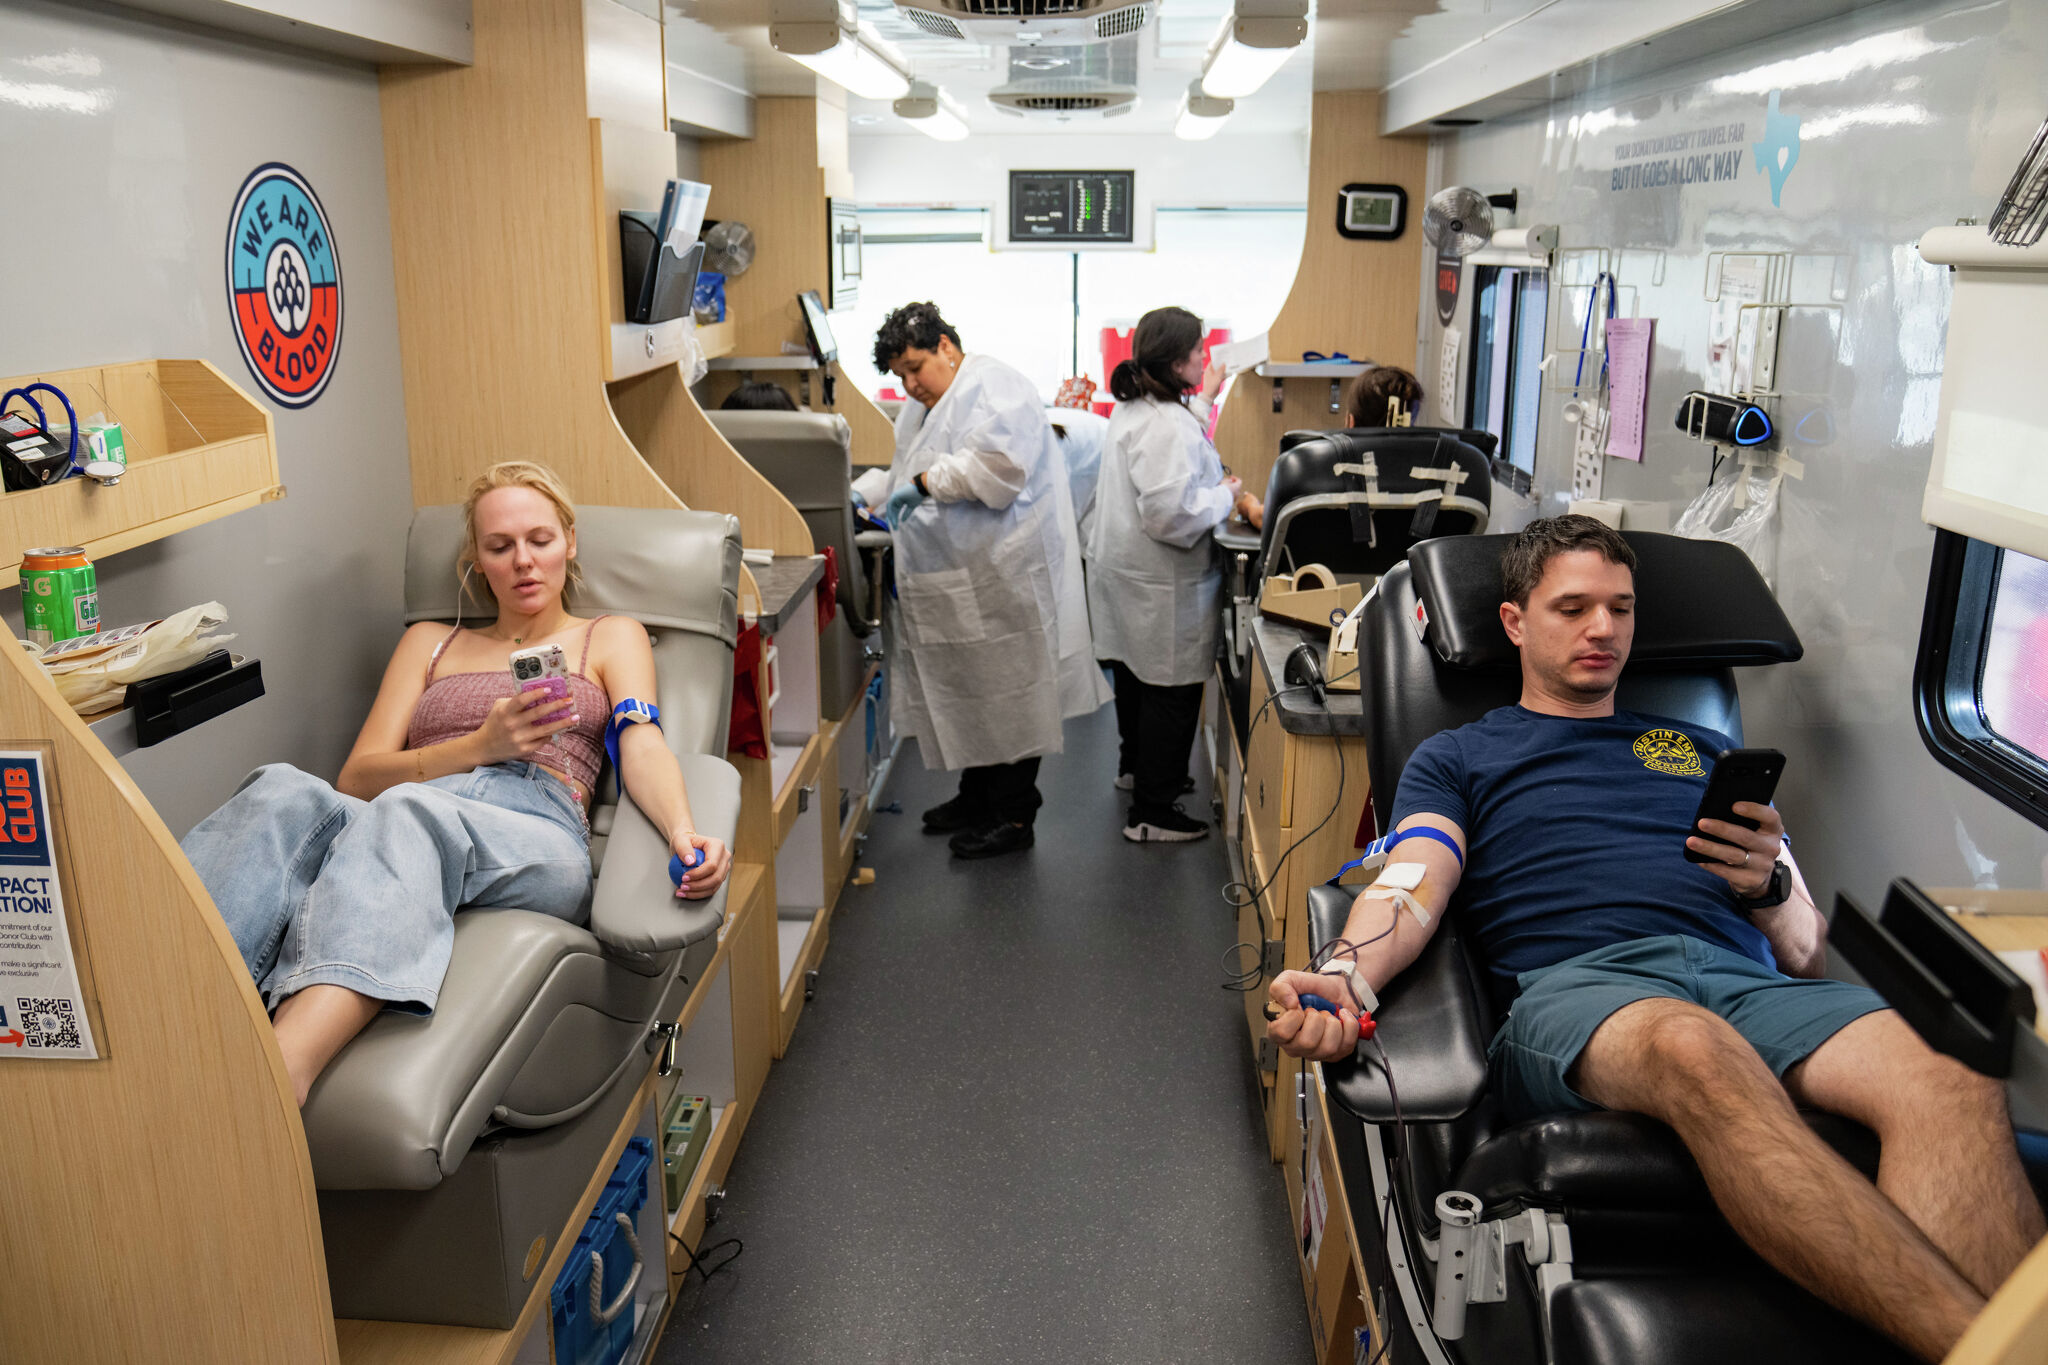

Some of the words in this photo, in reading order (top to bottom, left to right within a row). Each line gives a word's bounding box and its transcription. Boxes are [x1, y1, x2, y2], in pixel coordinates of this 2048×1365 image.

[1697, 125, 1727, 149] TRAVEL
[1727, 122, 1745, 143] FAR
[1611, 165, 1631, 191] BUT
[1630, 163, 1642, 189] IT
[1642, 159, 1670, 188] GOES
[1669, 157, 1678, 185] A
[1678, 153, 1712, 185] LONG
[1713, 149, 1743, 181] WAY
[242, 199, 273, 259] WE
[279, 193, 323, 260] ARE
[258, 323, 327, 382] BLOOD
[1635, 731, 1673, 753] AUSTIN
[1676, 736, 1696, 758] EMS
[4, 767, 37, 843] CLUB
[0, 877, 50, 894] PACT
[27, 961, 62, 970] significant
